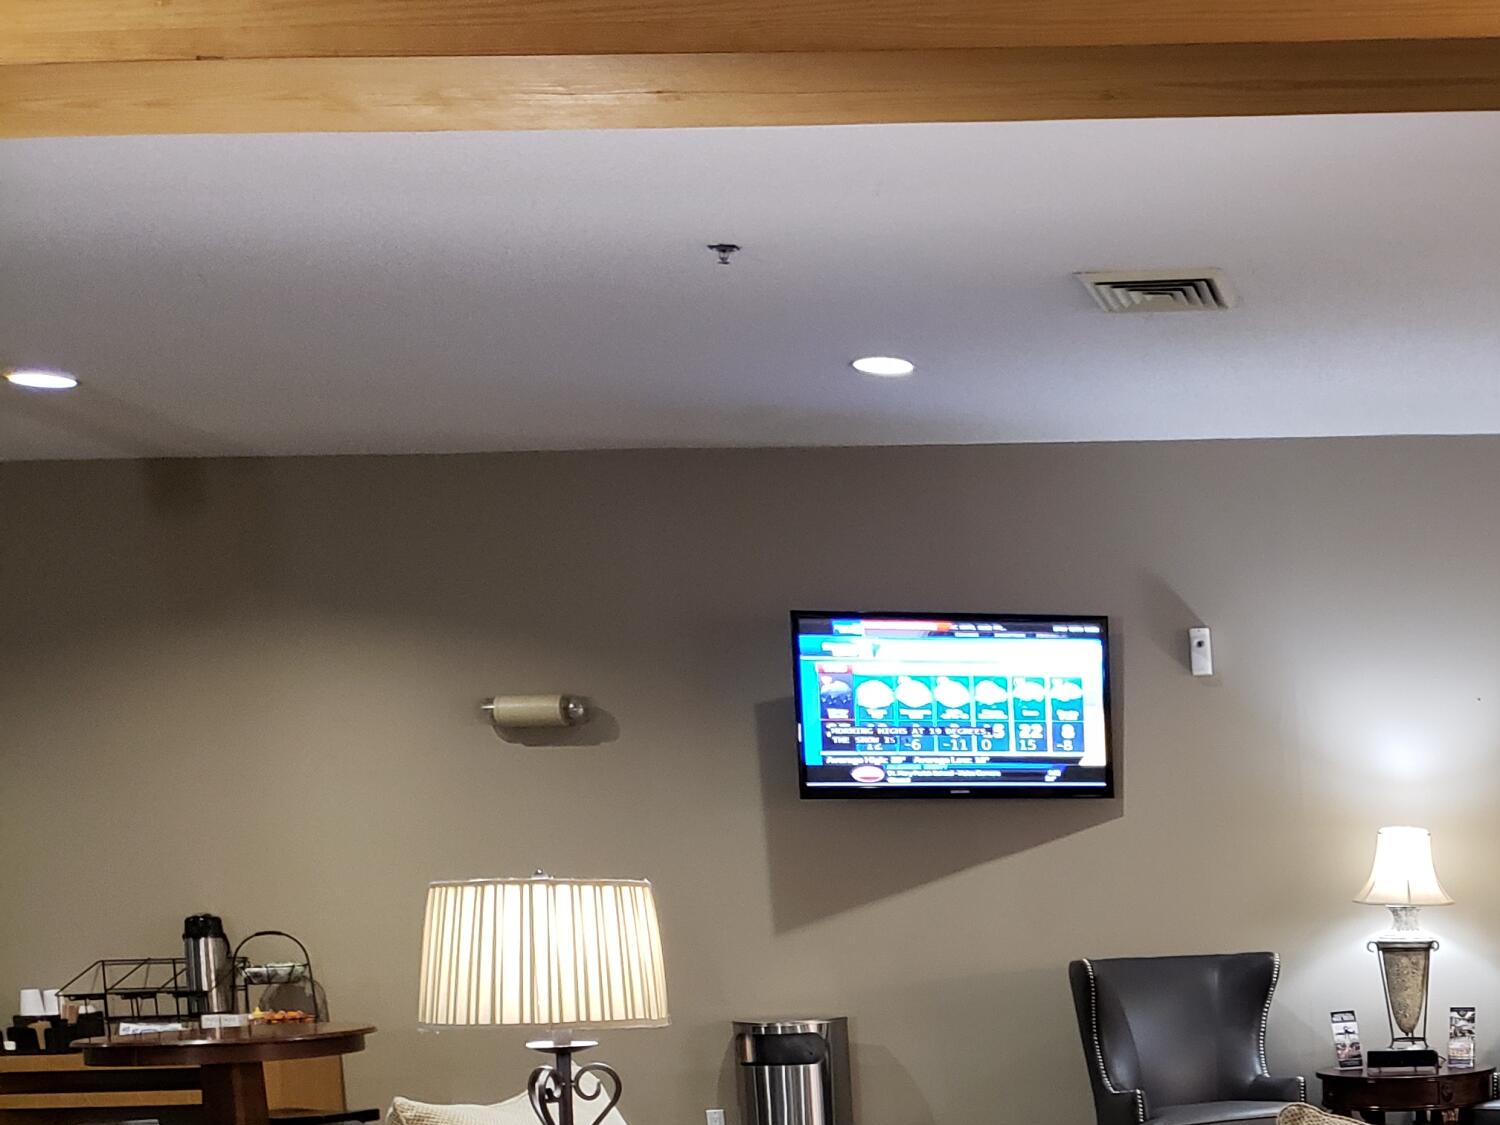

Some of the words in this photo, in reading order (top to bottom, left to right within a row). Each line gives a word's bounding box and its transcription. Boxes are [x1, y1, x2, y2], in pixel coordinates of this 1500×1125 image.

[911, 727, 926, 735] AT
[1018, 723, 1044, 738] 22
[832, 736, 850, 744] THE
[884, 736, 896, 744] IS
[1019, 739, 1037, 751] 15
